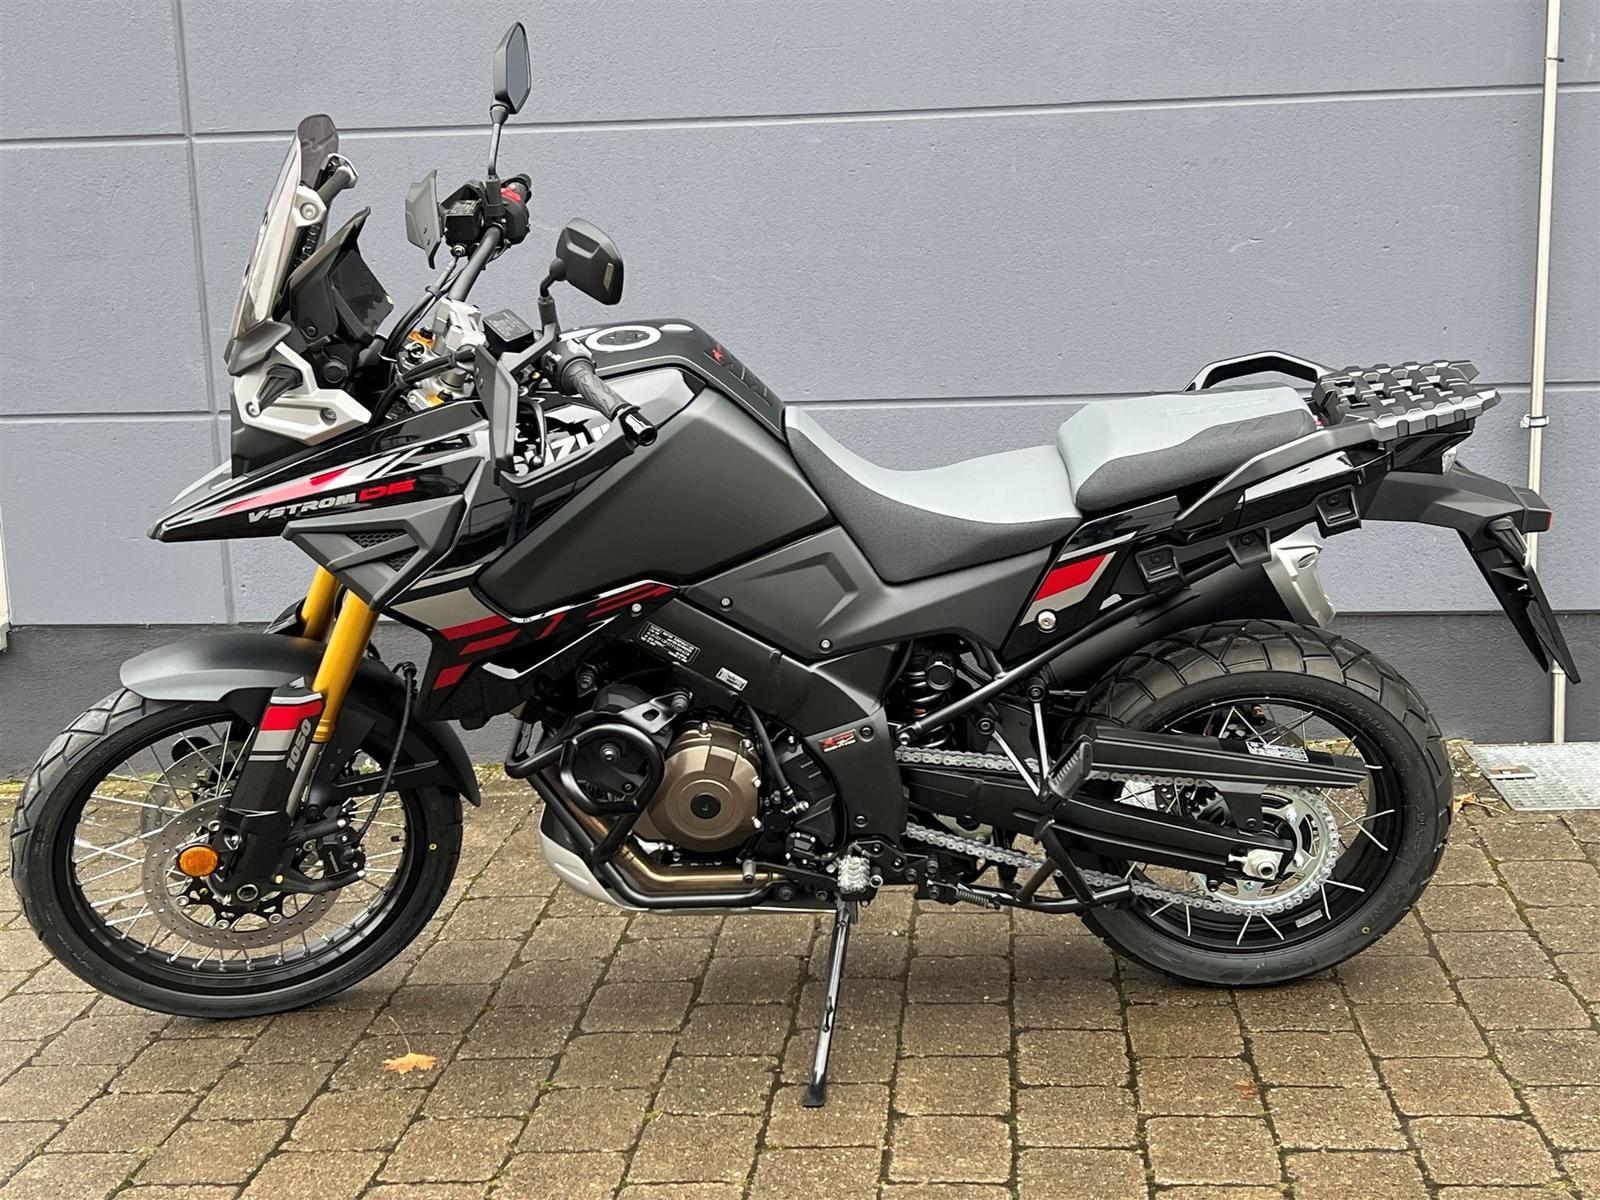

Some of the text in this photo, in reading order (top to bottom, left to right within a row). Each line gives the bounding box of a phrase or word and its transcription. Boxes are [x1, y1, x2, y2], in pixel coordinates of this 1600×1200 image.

[513, 422, 611, 477] SUZU
[248, 478, 416, 523] V-STROM DE
[286, 718, 312, 772] 1050
